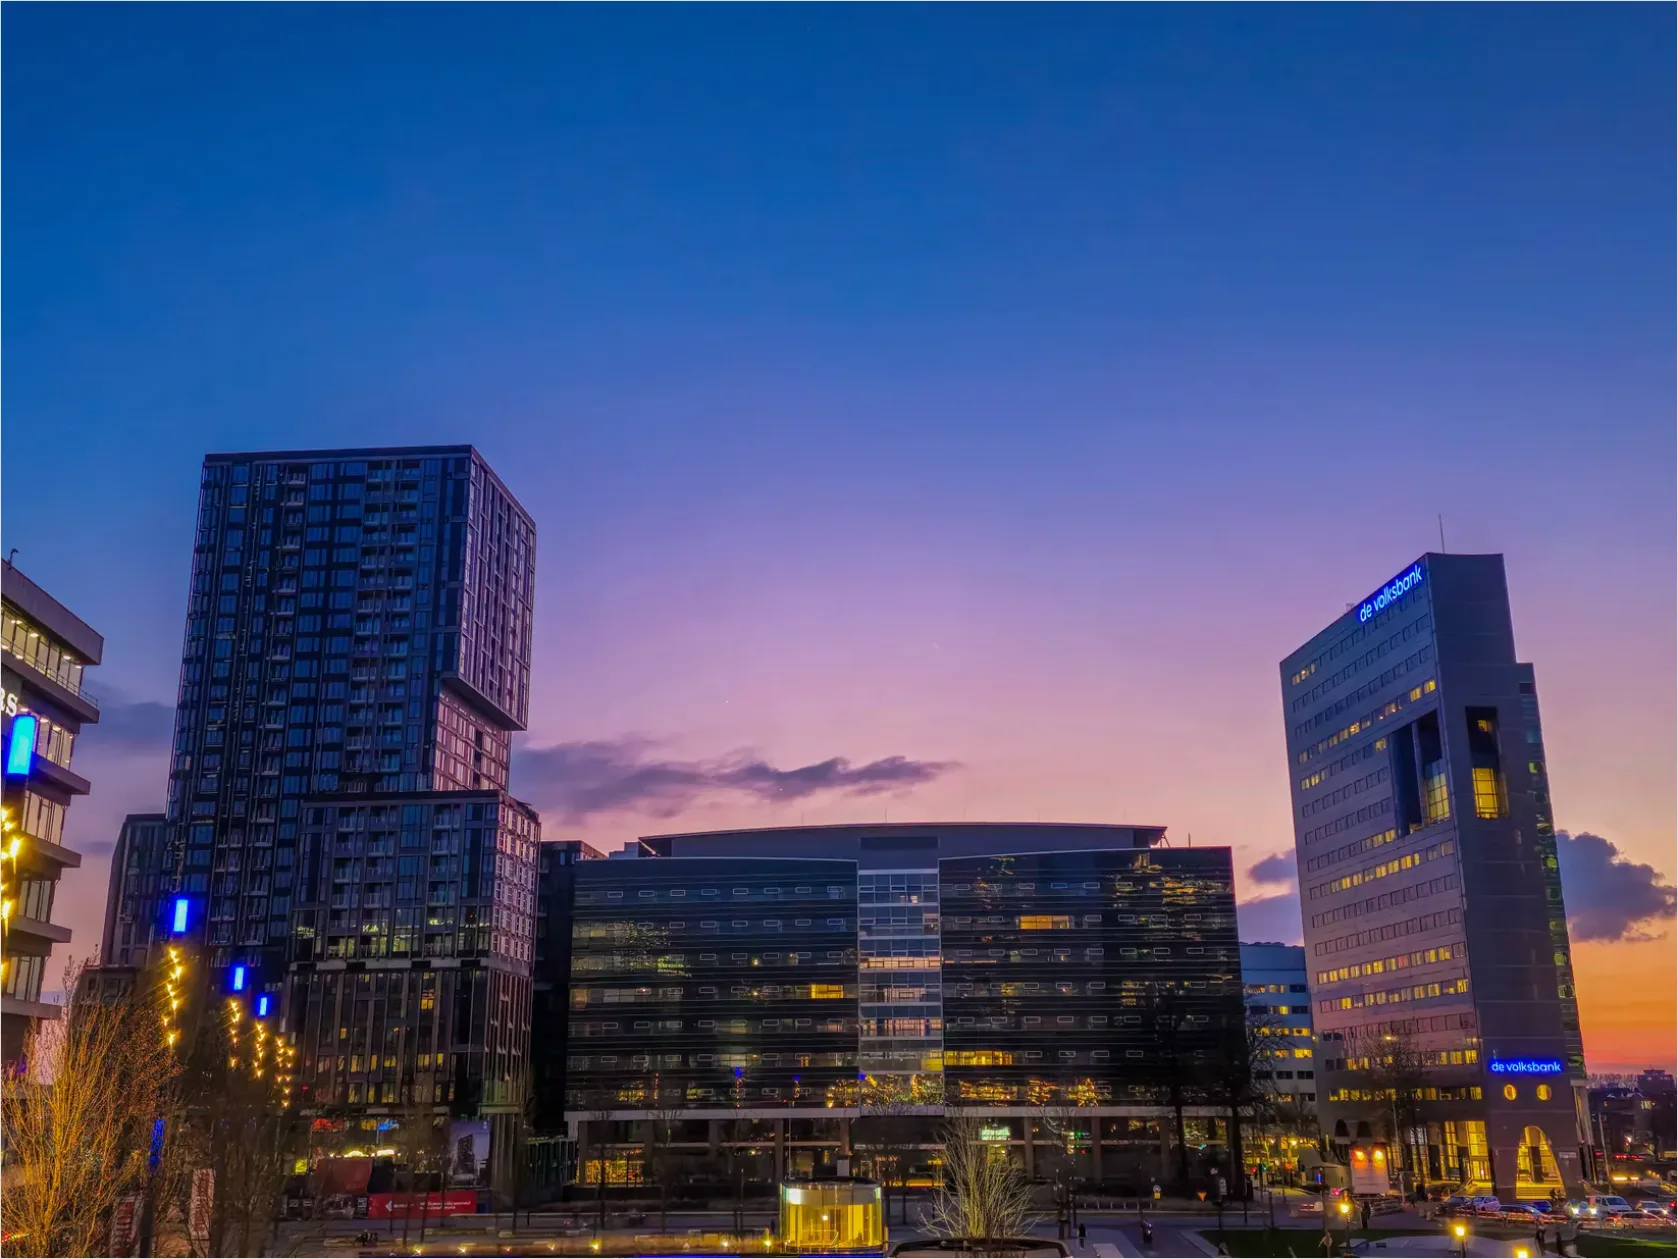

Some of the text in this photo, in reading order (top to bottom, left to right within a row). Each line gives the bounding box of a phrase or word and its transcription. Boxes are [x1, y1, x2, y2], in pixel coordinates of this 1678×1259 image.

[1360, 564, 1422, 622] de volksbank
[1491, 1061, 1561, 1072] de volksbank
